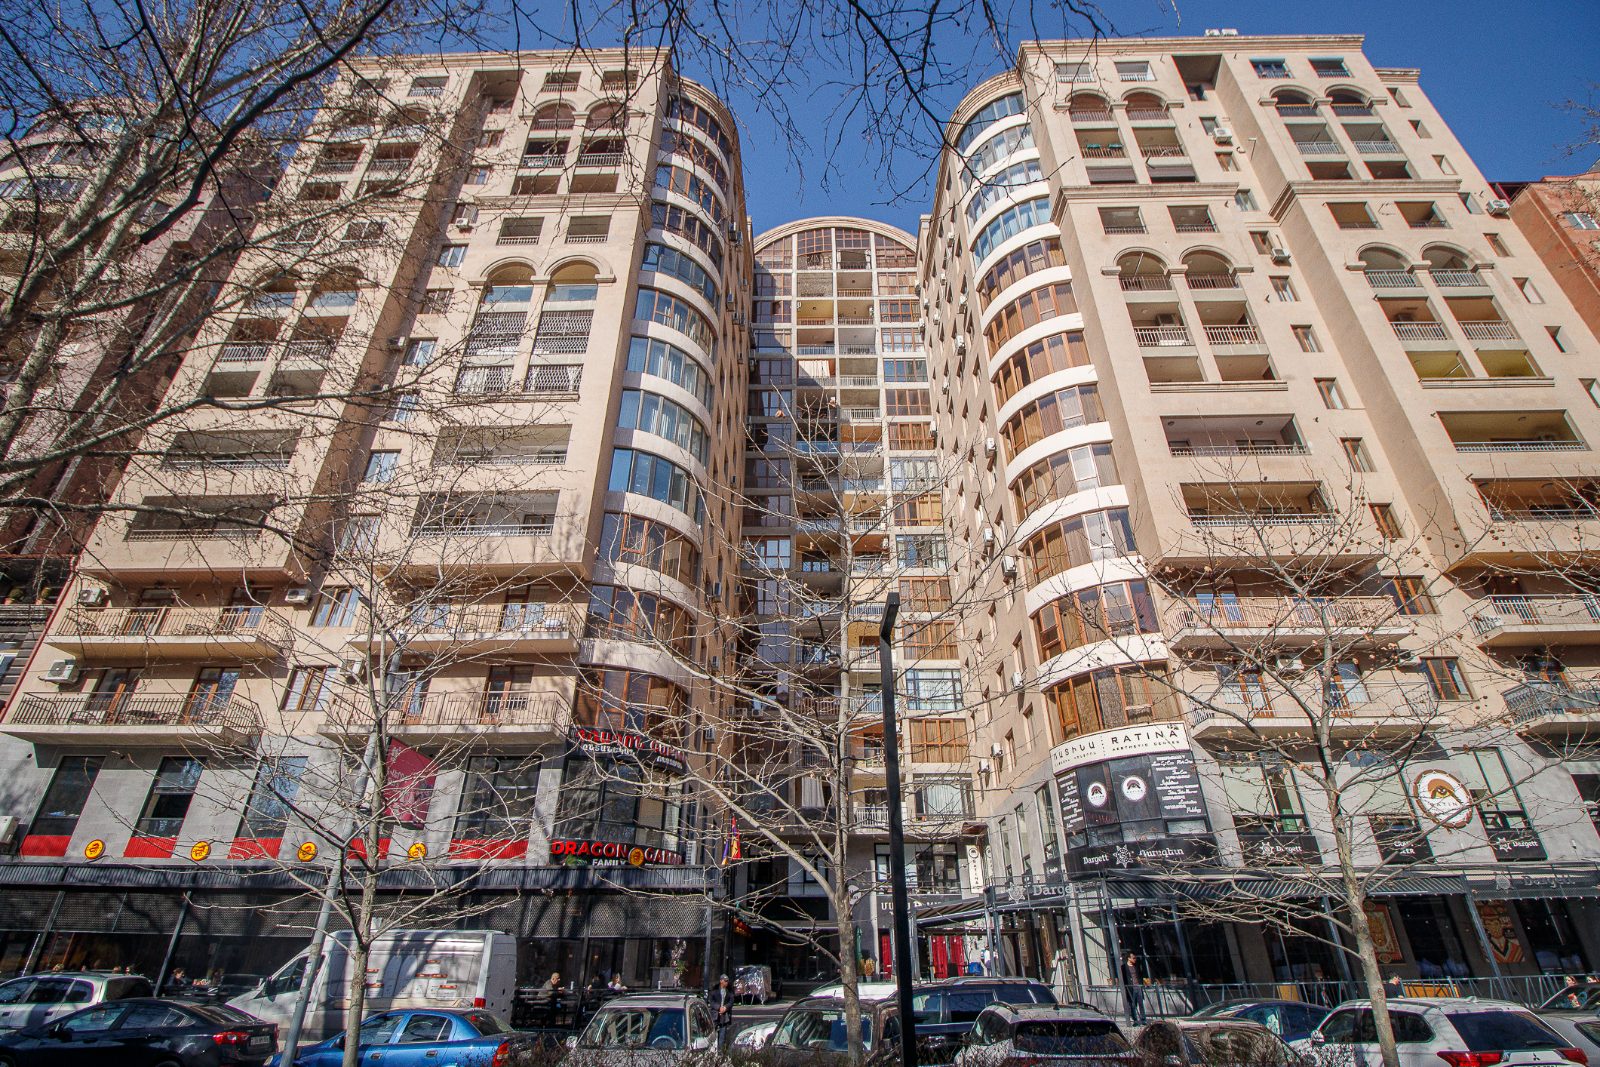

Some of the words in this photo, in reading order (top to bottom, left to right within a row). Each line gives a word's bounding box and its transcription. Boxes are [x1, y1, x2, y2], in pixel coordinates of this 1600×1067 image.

[1111, 730, 1178, 745] RATINA
[550, 841, 627, 858] DRAGON
[1082, 853, 1110, 865] Dargett
[1032, 882, 1085, 898] Dargett
